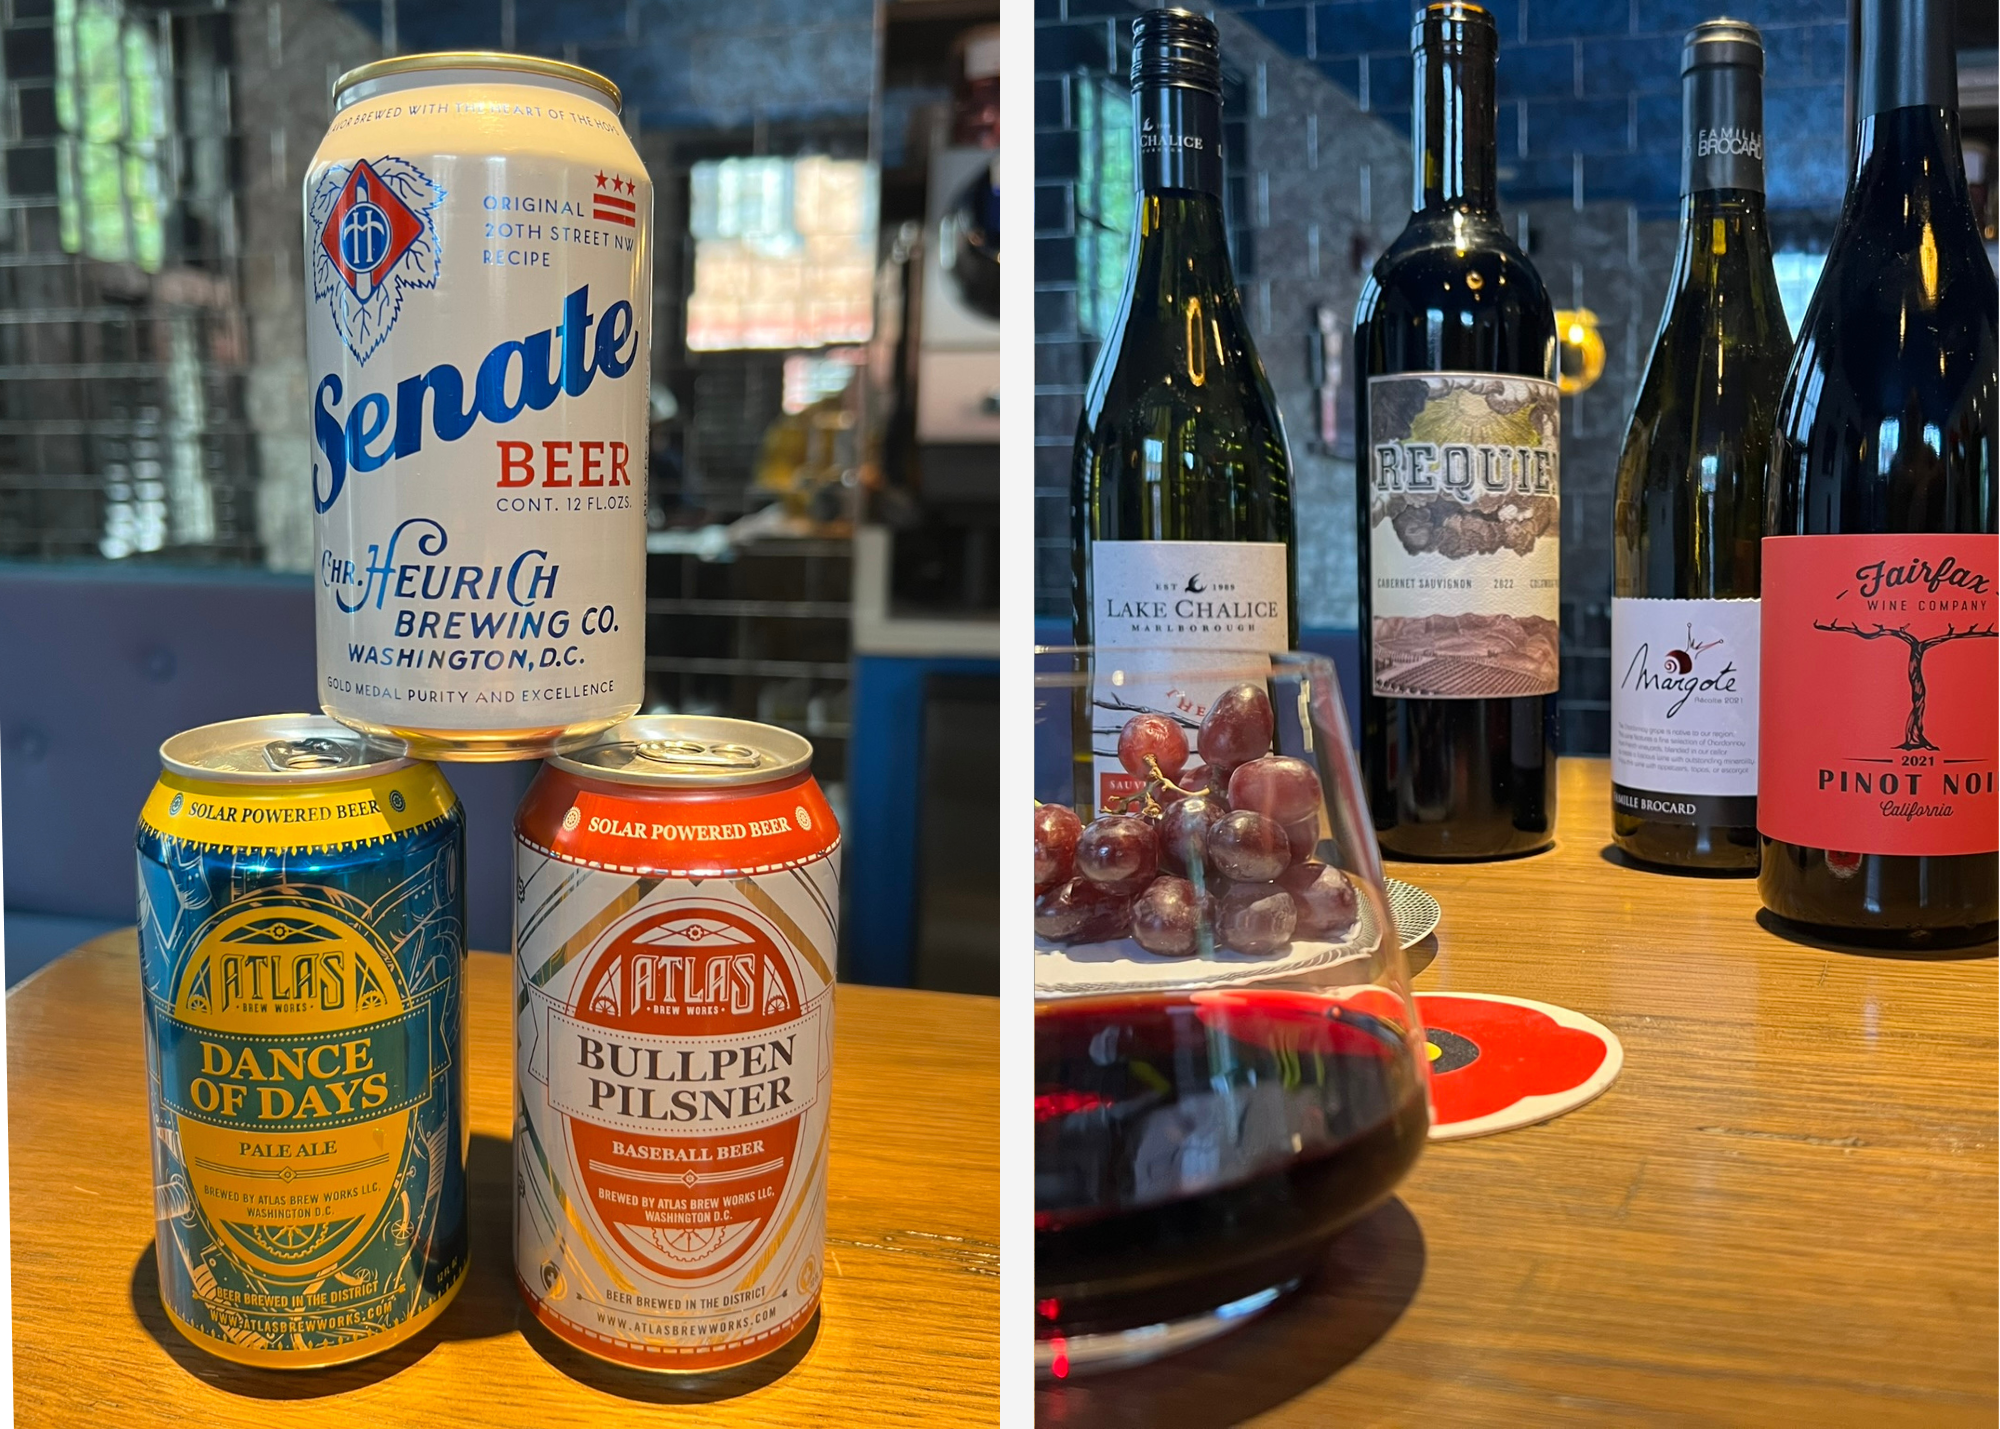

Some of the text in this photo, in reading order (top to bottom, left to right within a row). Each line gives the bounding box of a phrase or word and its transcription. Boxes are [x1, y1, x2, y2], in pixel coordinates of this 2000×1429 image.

[353, 107, 402, 125] BREWED
[409, 103, 448, 115] WITH
[455, 102, 484, 113] THE
[490, 101, 542, 117] HEART
[547, 109, 565, 120] OF
[570, 112, 593, 127] THE
[1140, 134, 1204, 150] CHALICE
[483, 195, 585, 218] ORIGINAL
[484, 223, 635, 252] 20TH STREET NW
[483, 250, 551, 268] RECIPE
[313, 284, 639, 515] Senate
[496, 440, 631, 488] BEER
[496, 497, 559, 512] CONT.
[566, 497, 581, 511] 12
[321, 518, 560, 614] CHR. HEURICH
[1855, 556, 1990, 599] Fairfax
[1155, 583, 1178, 591] EST
[1377, 578, 1416, 589] CABERNET
[1419, 578, 1472, 589] SAUVIGNON
[1493, 579, 1514, 589] 2022
[1107, 598, 1278, 619] LAKE CHALICE
[1866, 599, 1987, 612] WINE COMPANY
[394, 604, 619, 639] BREWING CO.
[1131, 624, 1256, 633] MARLBOROUGH
[327, 675, 614, 703] GOLD MEDAL PURITY AND EXCELLENCE
[1621, 642, 1737, 719] Margote
[1724, 696, 1744, 704] 2021
[1901, 755, 1935, 767] 2021
[1818, 769, 1999, 796] PINOT NOI
[188, 799, 381, 824] SOLAR POWERED BEER
[1641, 799, 1697, 815] BROCARD
[1880, 800, 1954, 822] California
[587, 816, 792, 841] SOLAR POWERED BEER
[221, 950, 345, 1013] ATLAS
[630, 952, 756, 1016] ATLAS
[242, 1002, 308, 1013] BREW WORKS
[653, 1004, 720, 1016] BREW WORKS
[199, 1037, 374, 1082] DANCE
[577, 1033, 798, 1083] BULLPEN
[190, 1071, 389, 1120] OF DAYS
[588, 1076, 794, 1122] PILSNER
[239, 1140, 338, 1158] PALE ALE
[612, 1139, 765, 1162] BASEBALL BEER
[203, 1184, 240, 1203] BREWED
[243, 1194, 255, 1205] BY
[258, 1194, 287, 1206] ATLAS
[289, 1192, 319, 1206] BREW
[323, 1187, 359, 1204] WORKS
[598, 1187, 639, 1207] BREWED
[641, 1197, 656, 1209] BY
[657, 1198, 688, 1211] ATLAS
[690, 1197, 721, 1211] BREW
[723, 1191, 756, 1209] WORKS
[246, 1205, 335, 1219] WASHINGTON D.C.
[644, 1209, 733, 1223] WASHINGTON D.C.
[216, 1280, 380, 1308] BEER BREWED IN THE DISTRICT
[605, 1285, 766, 1310] BEER BREWED IN THE DISTRICT
[209, 1300, 393, 1334] WWW.ATLASBREWWORKS.COM
[597, 1306, 776, 1336] WWW.ATLASBREWWORKS.COM
